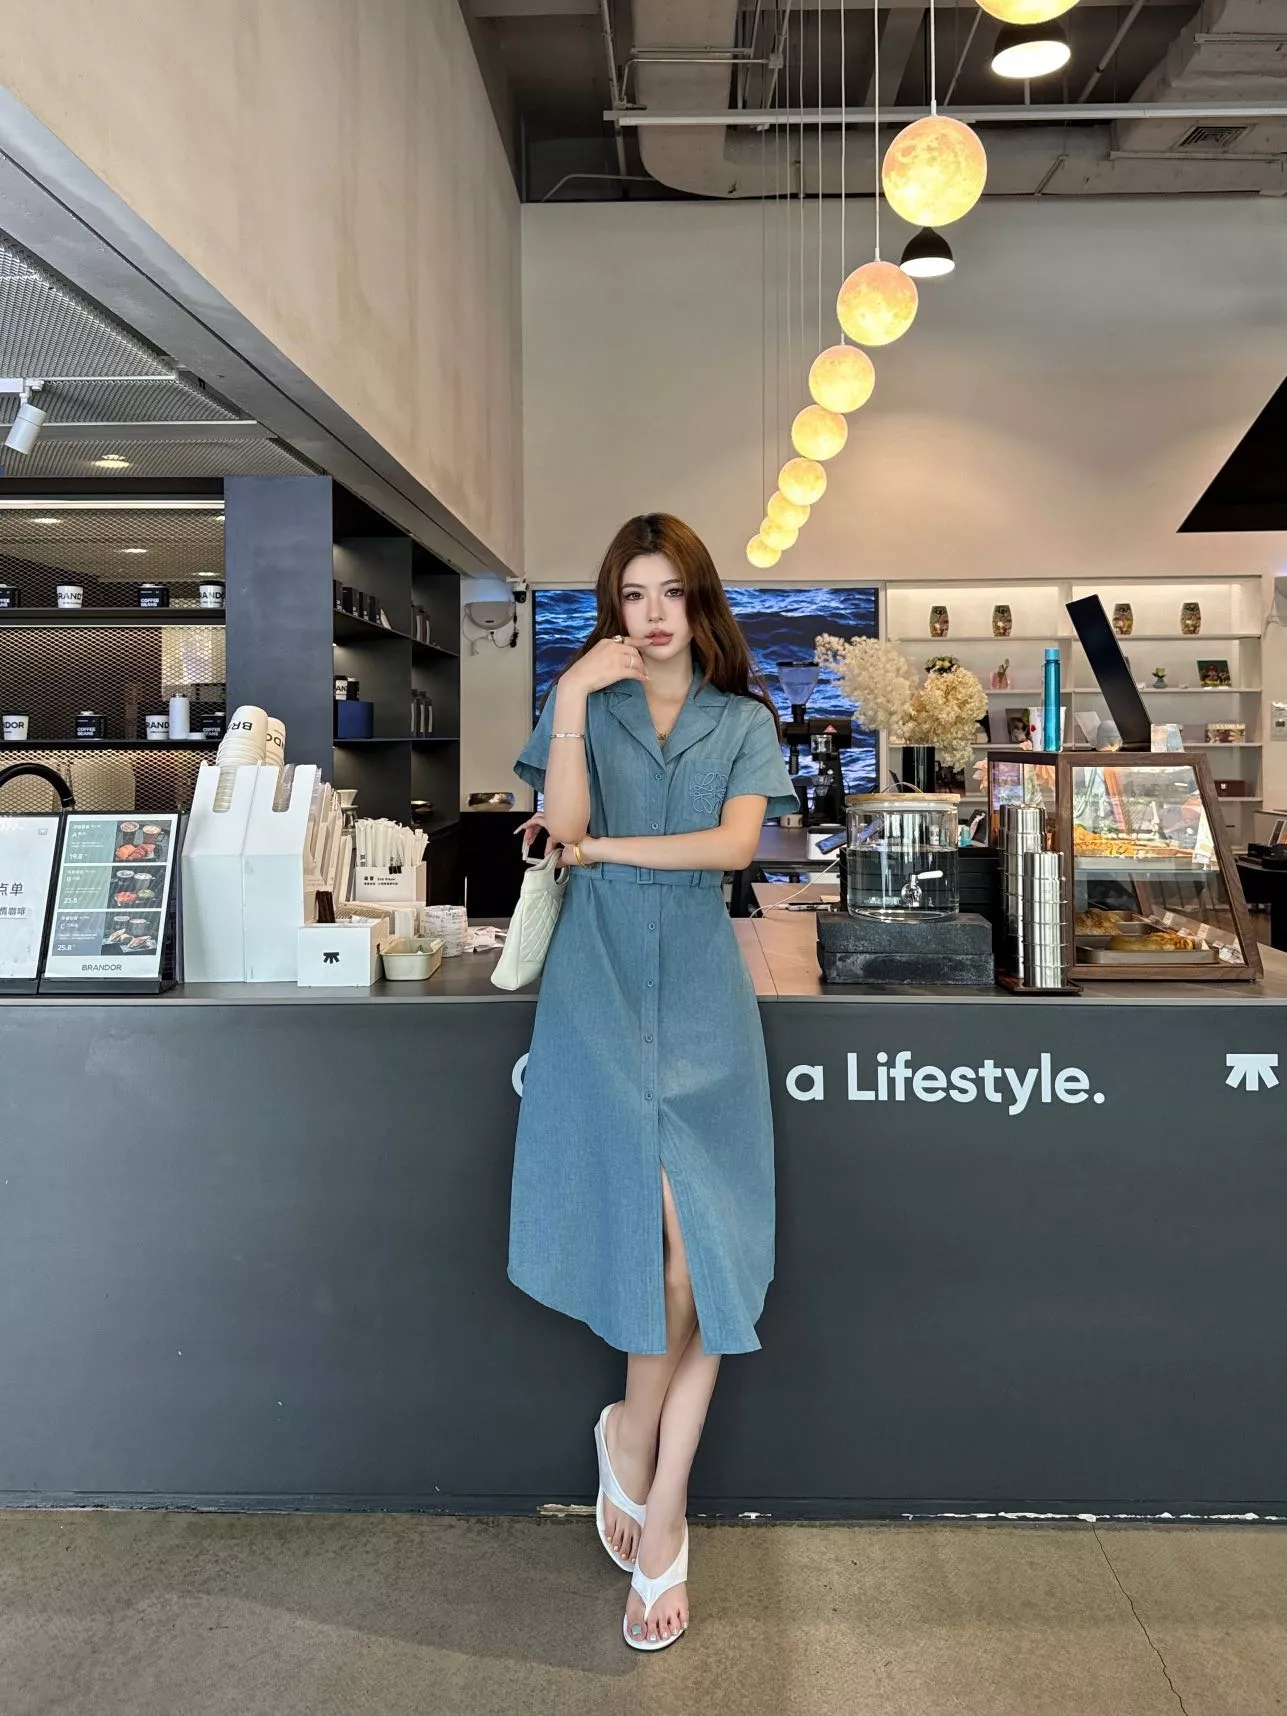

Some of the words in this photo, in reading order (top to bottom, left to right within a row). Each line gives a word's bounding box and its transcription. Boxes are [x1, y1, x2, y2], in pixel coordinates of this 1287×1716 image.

[228, 721, 253, 731] BR
[786, 1065, 825, 1102] a
[847, 1051, 1106, 1116] Lifestyle.
